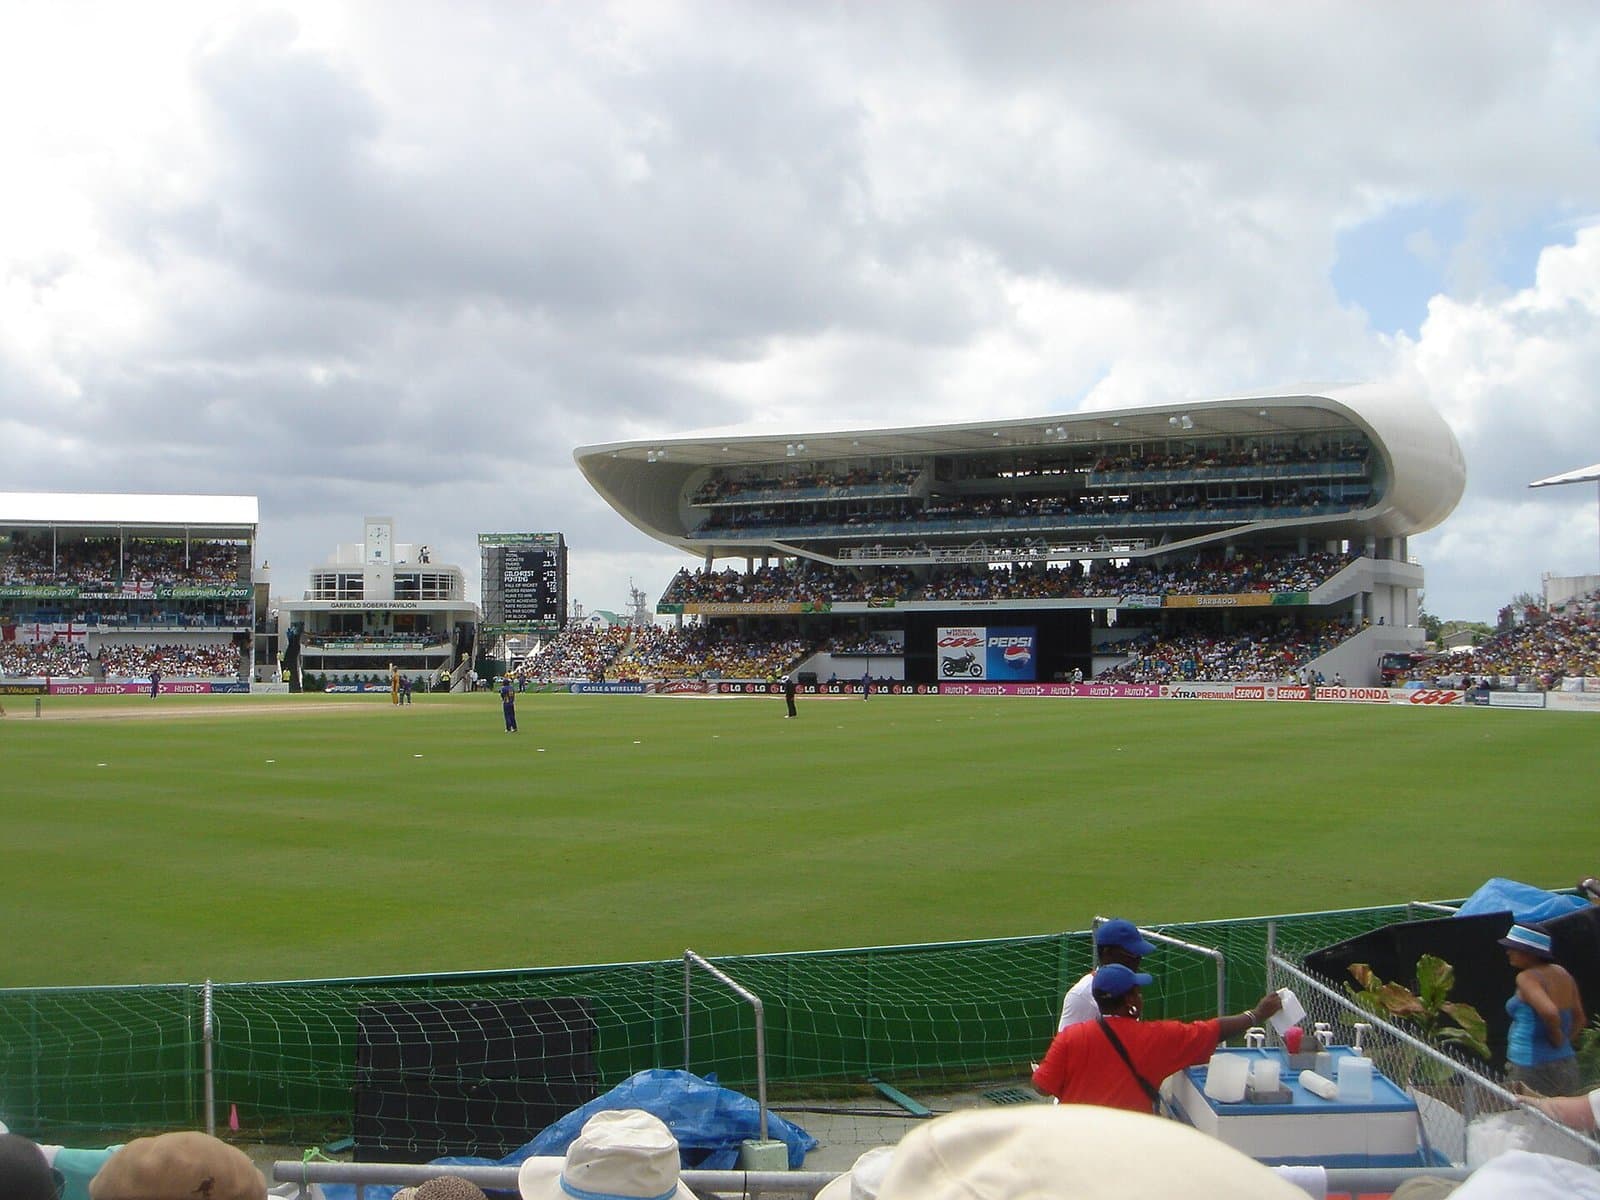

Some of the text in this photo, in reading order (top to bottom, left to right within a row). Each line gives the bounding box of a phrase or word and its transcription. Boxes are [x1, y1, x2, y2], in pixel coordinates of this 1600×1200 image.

[22, 587, 41, 596] World
[43, 588, 56, 598] Cup
[58, 588, 75, 596] 2007
[160, 588, 248, 598] ICC Cricket World Cup 2007
[1197, 597, 1237, 605] BARBADOS
[757, 604, 770, 613] Cup
[771, 603, 789, 611] 2007
[987, 637, 1032, 647] PEPSI
[7, 686, 40, 694] WALKER
[137, 686, 151, 694] Hut
[804, 685, 815, 693] LG
[829, 685, 839, 693] LG
[1236, 688, 1262, 698] SERVO
[1278, 689, 1306, 699] SERVO
[1316, 689, 1347, 698] HERO
[1350, 689, 1389, 699] HONDA
